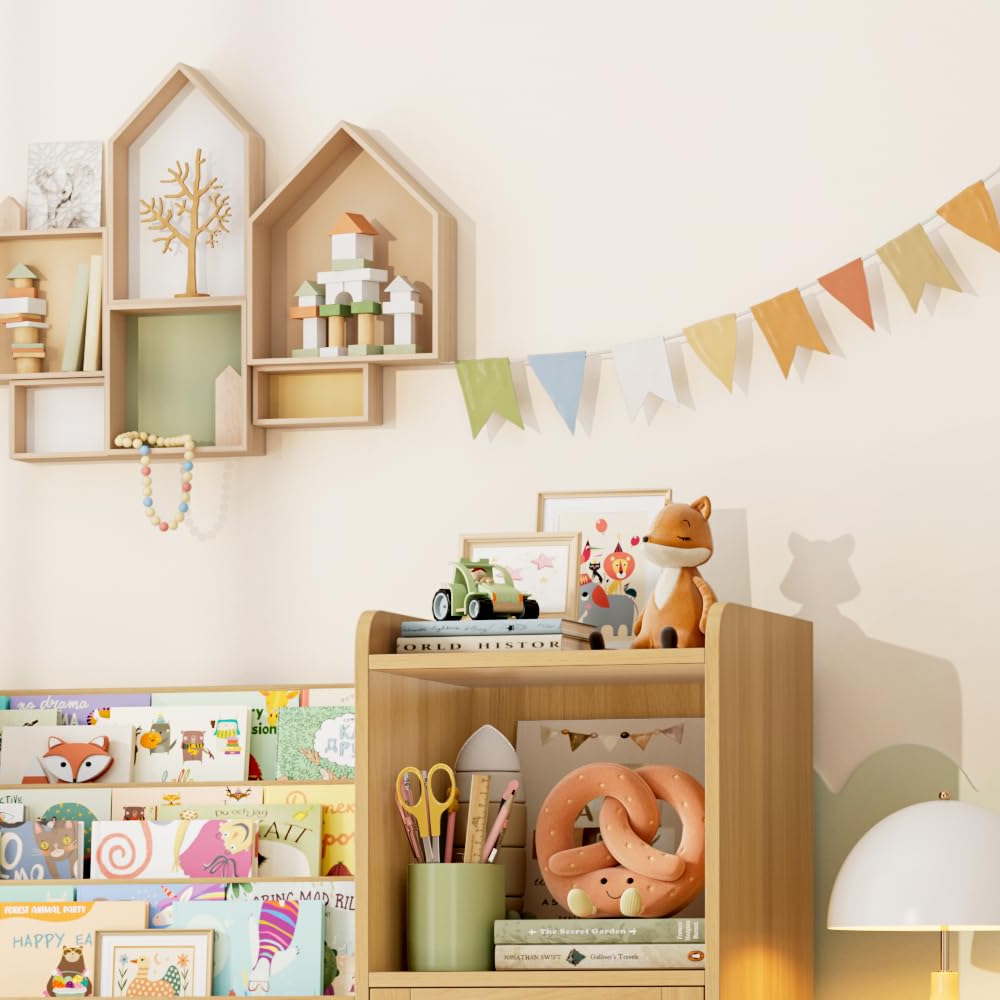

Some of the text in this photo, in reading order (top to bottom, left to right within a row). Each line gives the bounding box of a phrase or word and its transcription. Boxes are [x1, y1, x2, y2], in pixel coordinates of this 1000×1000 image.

[402, 643, 462, 651] ORLD
[40, 695, 89, 710] drama
[31, 905, 60, 914] ANIMAL
[63, 904, 87, 914] PARTY
[12, 932, 65, 949] HAPPY
[503, 953, 539, 961] JONATHAN
[540, 953, 561, 961] SWIFT
[618, 953, 639, 961] Travels
